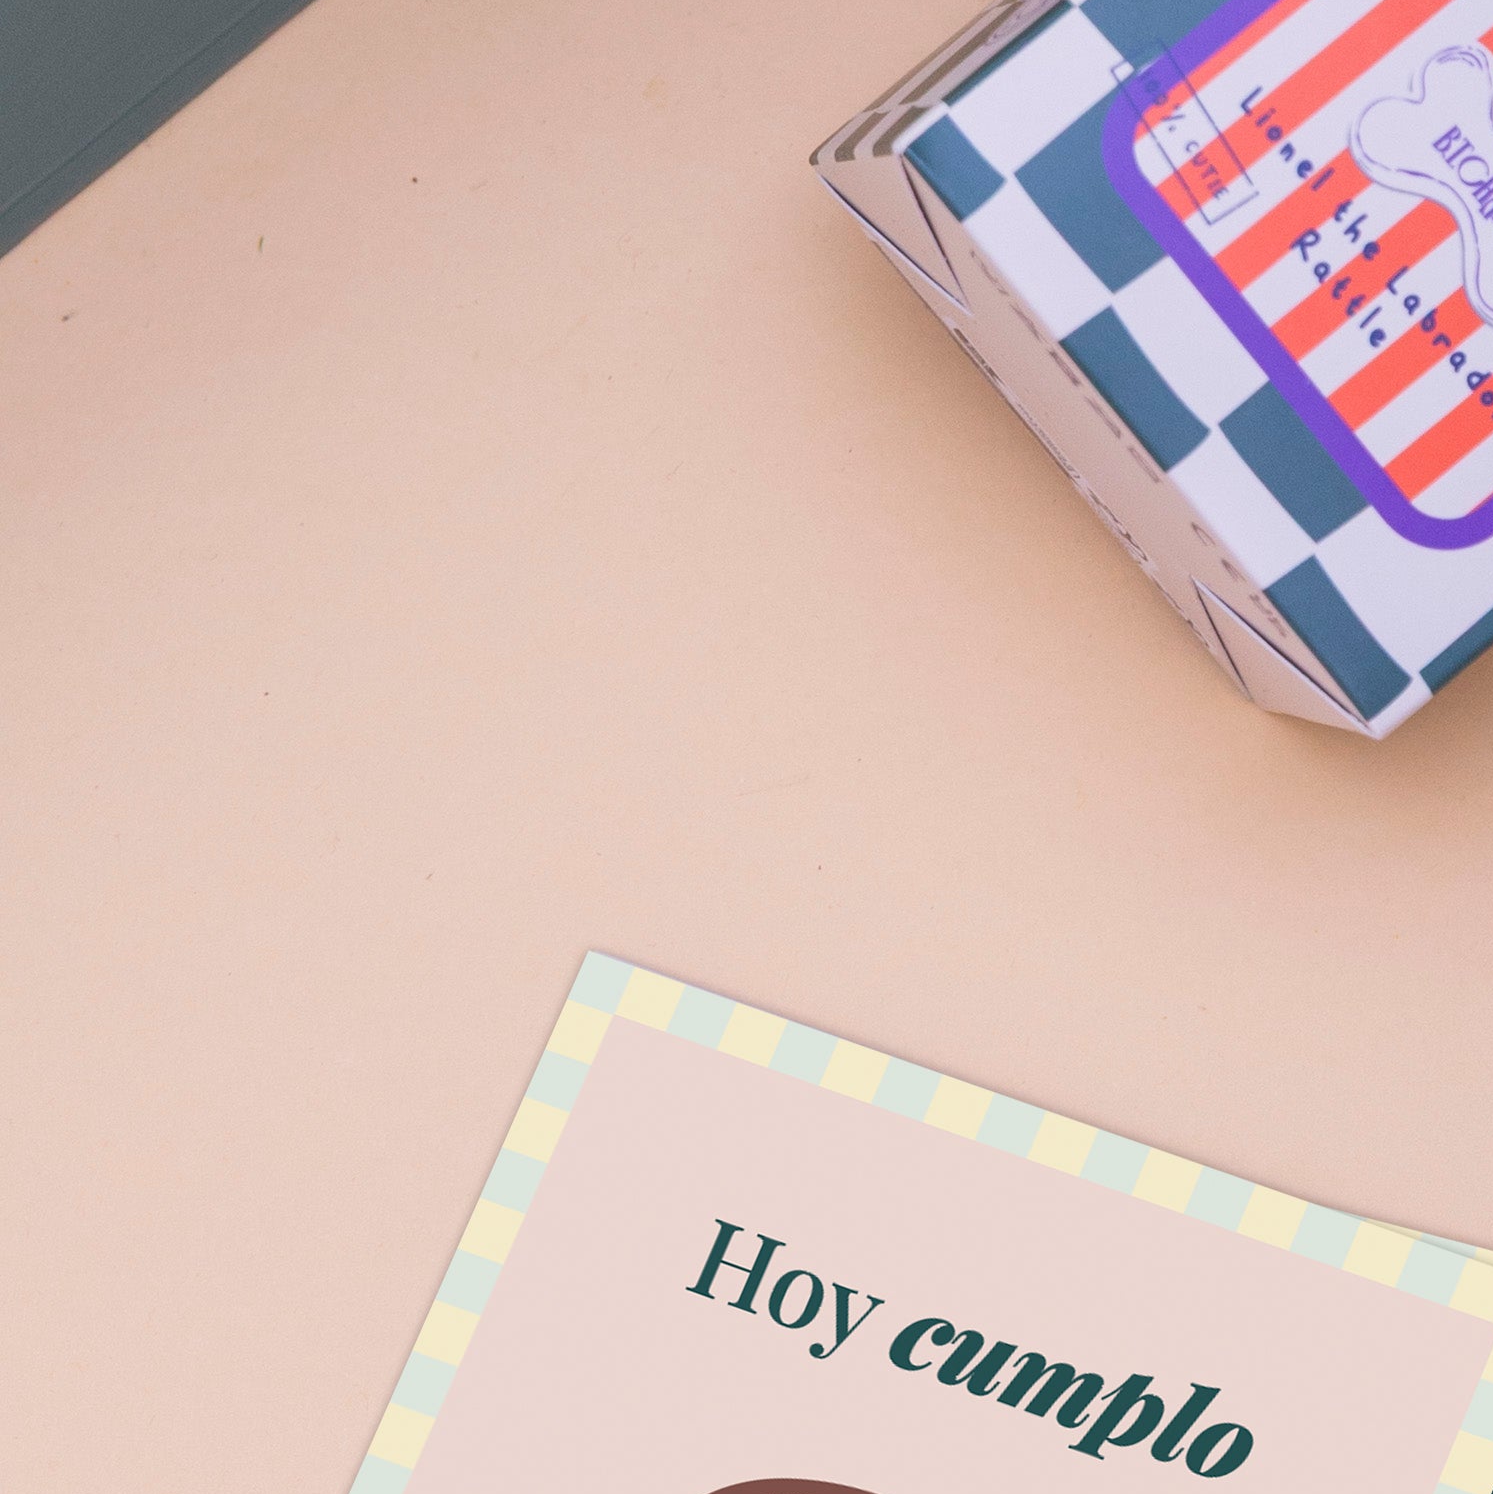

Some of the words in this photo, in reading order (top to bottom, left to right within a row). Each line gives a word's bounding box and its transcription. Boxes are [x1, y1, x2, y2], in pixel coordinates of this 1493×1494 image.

[1185, 140, 1229, 199] CUTIE
[1239, 86, 1336, 191] Lionel
[1333, 199, 1381, 261] the
[1289, 229, 1387, 348] Rattle
[686, 1217, 886, 1360] Hoy
[887, 1315, 1256, 1479] cumplo
